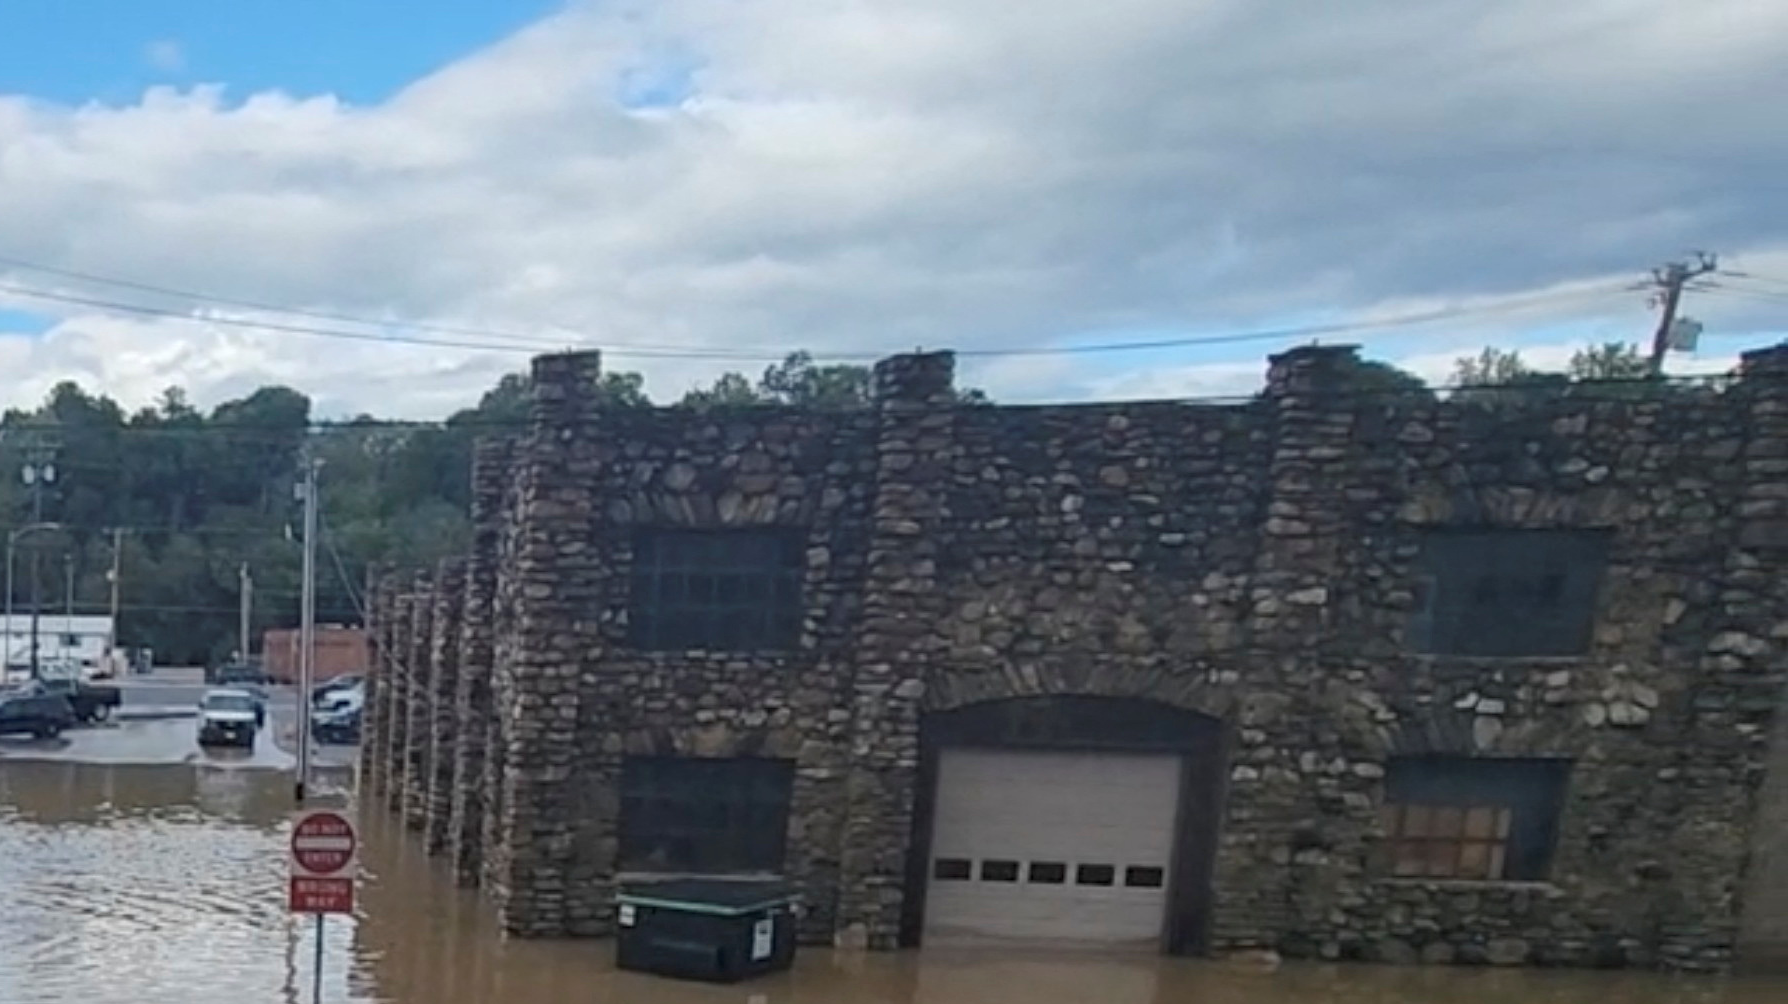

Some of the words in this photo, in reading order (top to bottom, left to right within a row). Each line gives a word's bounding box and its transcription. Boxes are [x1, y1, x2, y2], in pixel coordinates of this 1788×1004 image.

[301, 824, 318, 834] DO
[321, 824, 346, 834] NOT
[303, 852, 343, 863] ENTER
[297, 881, 348, 896] WRONG
[307, 896, 336, 907] WAY
